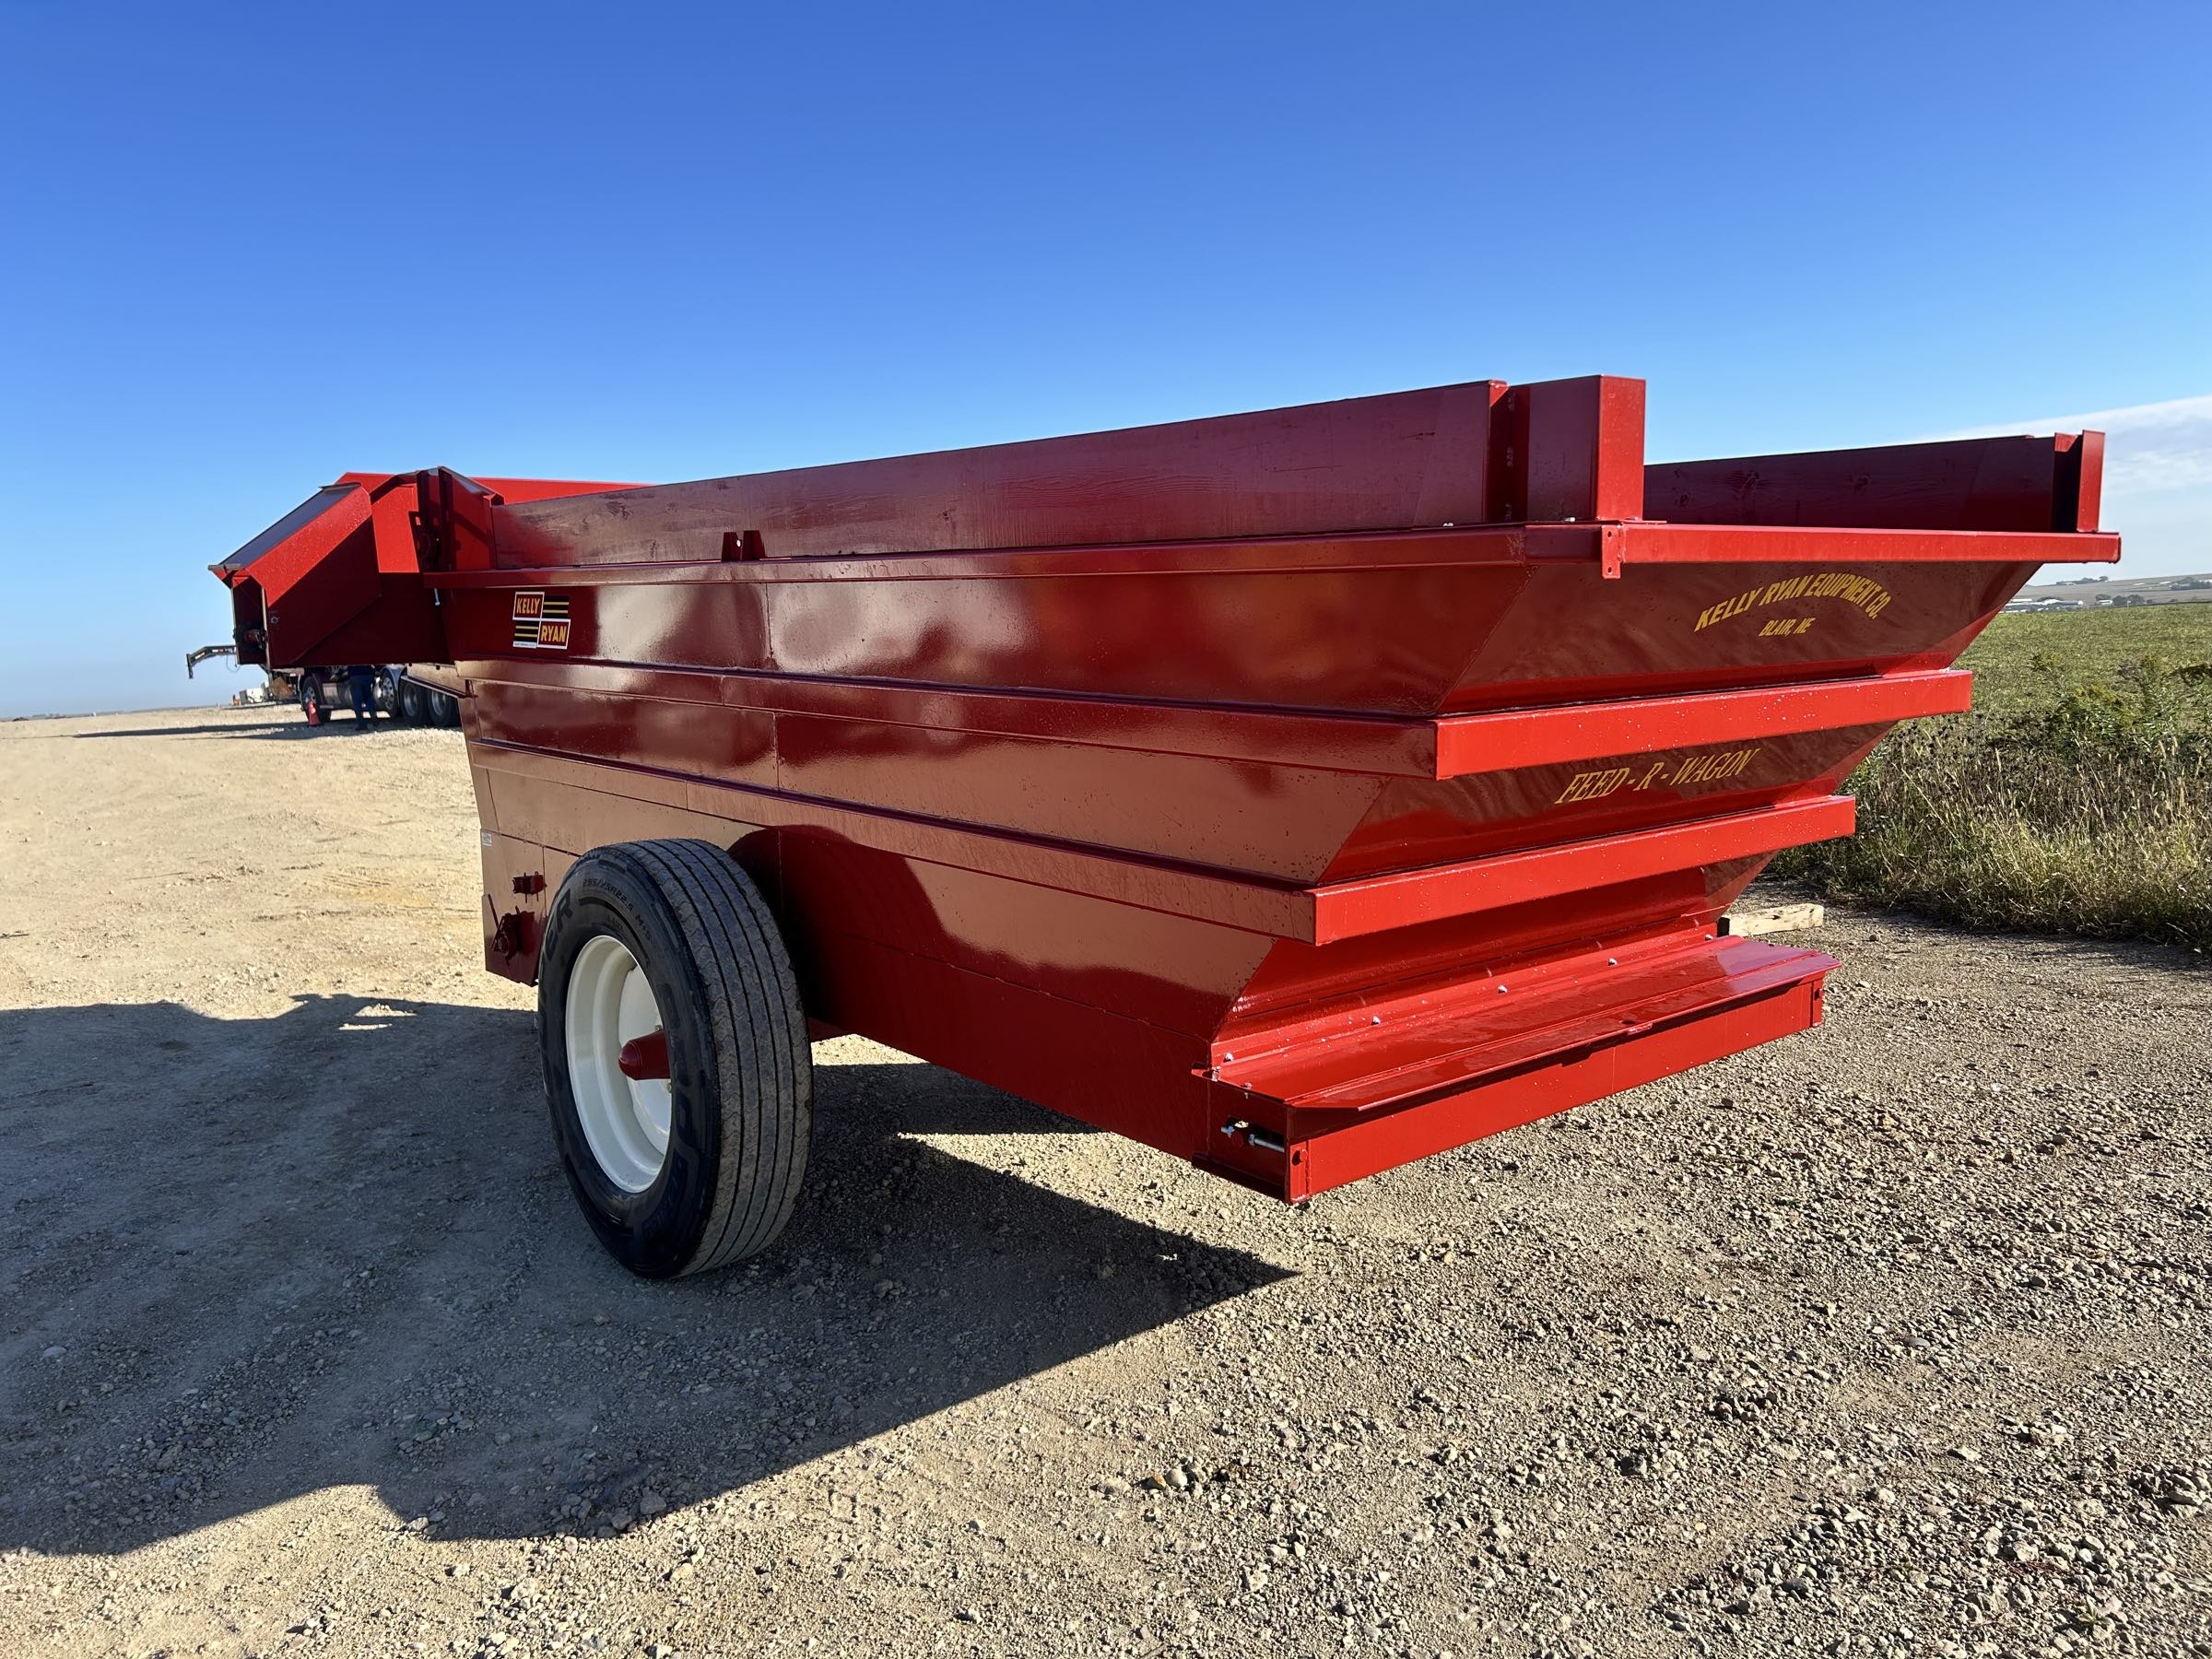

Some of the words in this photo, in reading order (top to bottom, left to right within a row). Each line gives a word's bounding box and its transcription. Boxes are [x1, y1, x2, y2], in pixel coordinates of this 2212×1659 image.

[516, 597, 541, 615] KELLY
[1694, 587, 1763, 632] KELLY
[1759, 576, 1814, 606] RYAN
[1804, 572, 1882, 607] EQUIPMENT
[1865, 592, 1892, 620] CO.
[540, 625, 567, 642] RYAN
[1758, 619, 1794, 637] BLAIR,
[1793, 617, 1817, 634] NE
[1554, 767, 1630, 804] FEED
[1669, 747, 1761, 786] WAGON
